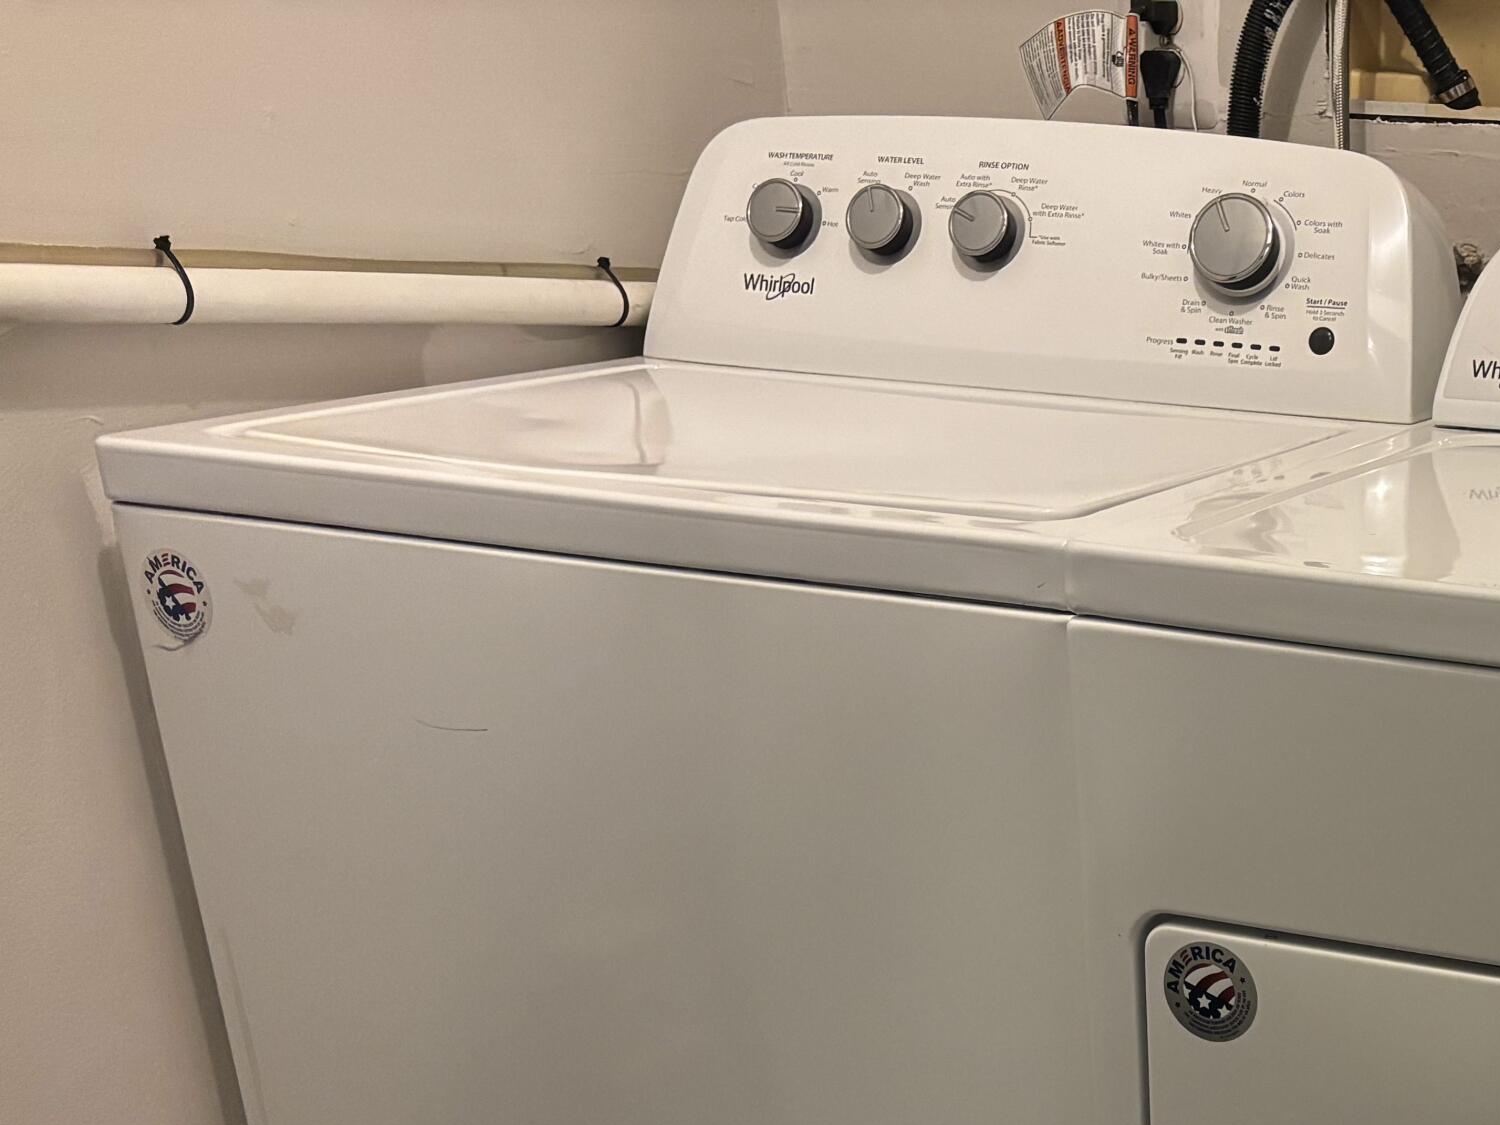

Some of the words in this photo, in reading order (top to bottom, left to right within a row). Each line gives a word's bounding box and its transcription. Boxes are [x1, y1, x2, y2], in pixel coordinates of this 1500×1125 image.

[1128, 38, 1137, 85] WARNING
[768, 151, 788, 159] WASH
[789, 152, 834, 161] TEMPERATURE
[878, 156, 902, 164] WATER
[903, 157, 925, 165] LEVEL
[978, 161, 1000, 169] RINSE
[1000, 162, 1030, 171] OPTION
[904, 172, 921, 180] Deep
[1011, 176, 1028, 185] Deep
[1029, 177, 1048, 185] Water
[956, 180, 972, 188] Extra
[1242, 180, 1268, 188] Normal
[1201, 187, 1223, 195] Heavy
[1283, 190, 1305, 198] Colors
[1041, 203, 1058, 211] Deep
[1060, 203, 1079, 211] Water
[723, 215, 733, 223] Tap
[1169, 211, 1192, 219] Whites
[1304, 219, 1326, 227] Colors
[1327, 220, 1343, 228] with
[1142, 240, 1165, 248] Whites
[1166, 241, 1181, 249] with
[1304, 252, 1335, 260] Delicates
[1141, 272, 1183, 282] Bulky/Sheets
[1291, 275, 1311, 283] Quick
[744, 272, 815, 300] Whirlpool
[1305, 298, 1323, 306] Start
[1328, 299, 1348, 307] Pause
[1187, 306, 1202, 314] Spin
[1266, 304, 1284, 312] Rinse
[1271, 312, 1287, 320] Spin
[1209, 316, 1228, 324] Clean
[1228, 318, 1253, 326] Washer
[1146, 336, 1174, 346] Progress
[144, 552, 204, 594] AMERICA
[1167, 945, 1237, 994] AMERICA
